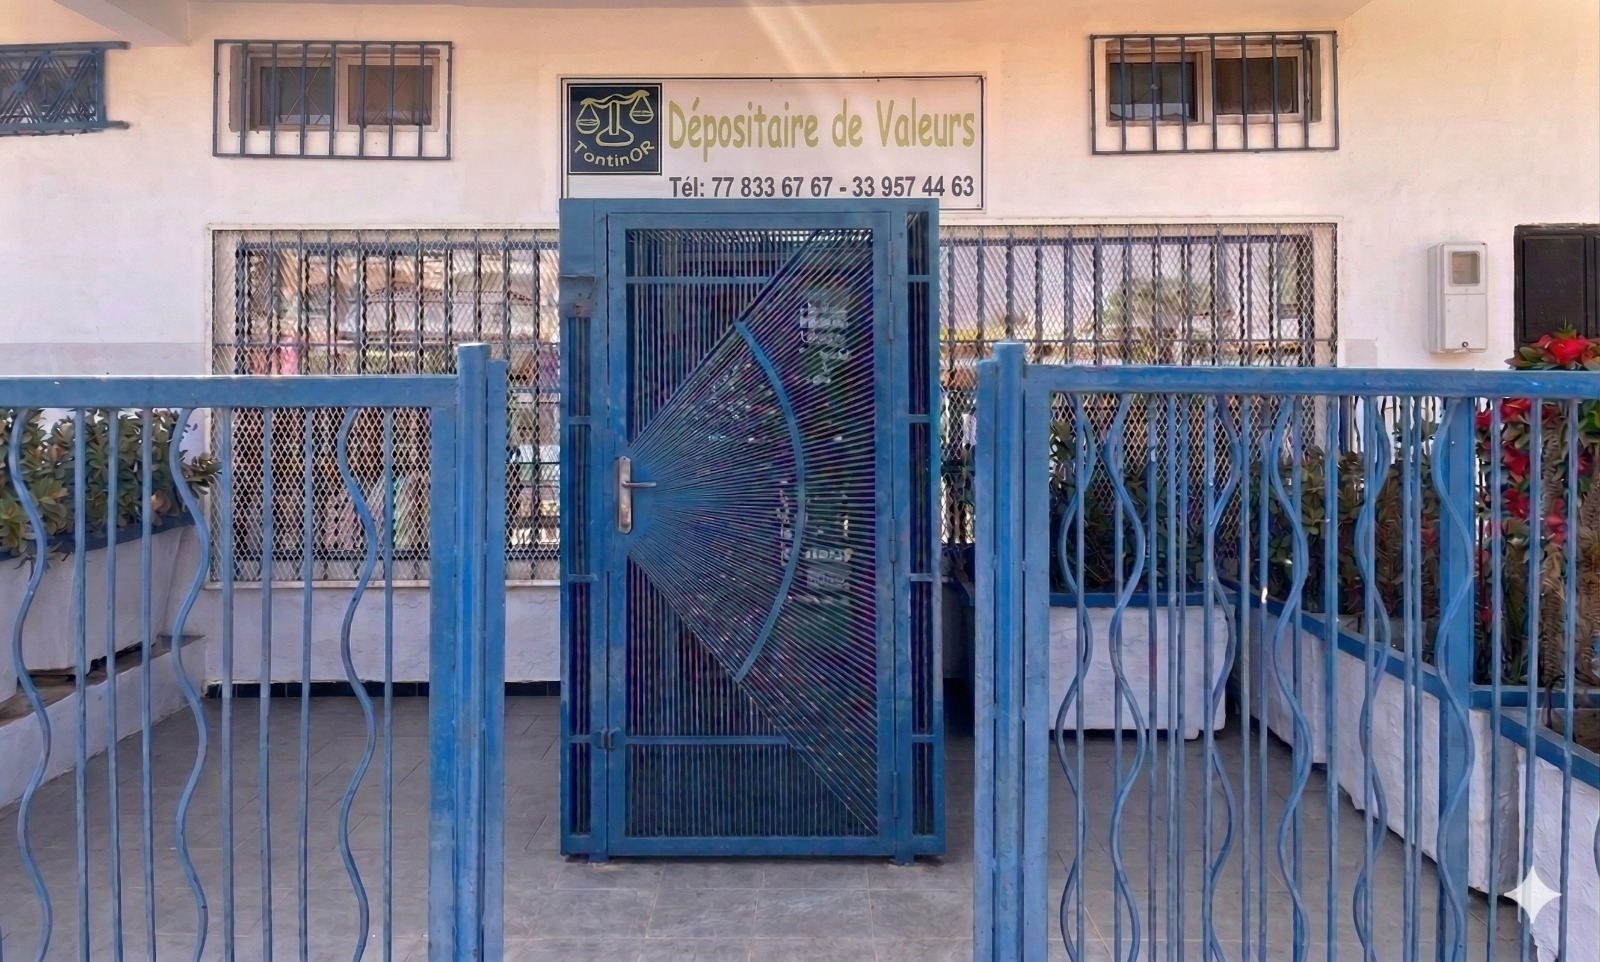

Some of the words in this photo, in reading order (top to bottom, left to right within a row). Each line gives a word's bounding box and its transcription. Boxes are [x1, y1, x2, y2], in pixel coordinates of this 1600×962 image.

[668, 97, 820, 163] Dépositaire
[831, 98, 863, 148] de
[875, 98, 976, 148] Valeurs
[574, 140, 655, 167] TontinOR
[669, 176, 705, 198] Tél:
[711, 176, 735, 198] 77
[740, 176, 776, 198] 833
[781, 176, 804, 198] 67
[810, 176, 833, 198] 67
[852, 176, 875, 197] 33
[881, 176, 916, 197] 957
[921, 176, 946, 197] 44
[951, 175, 974, 197] 63
